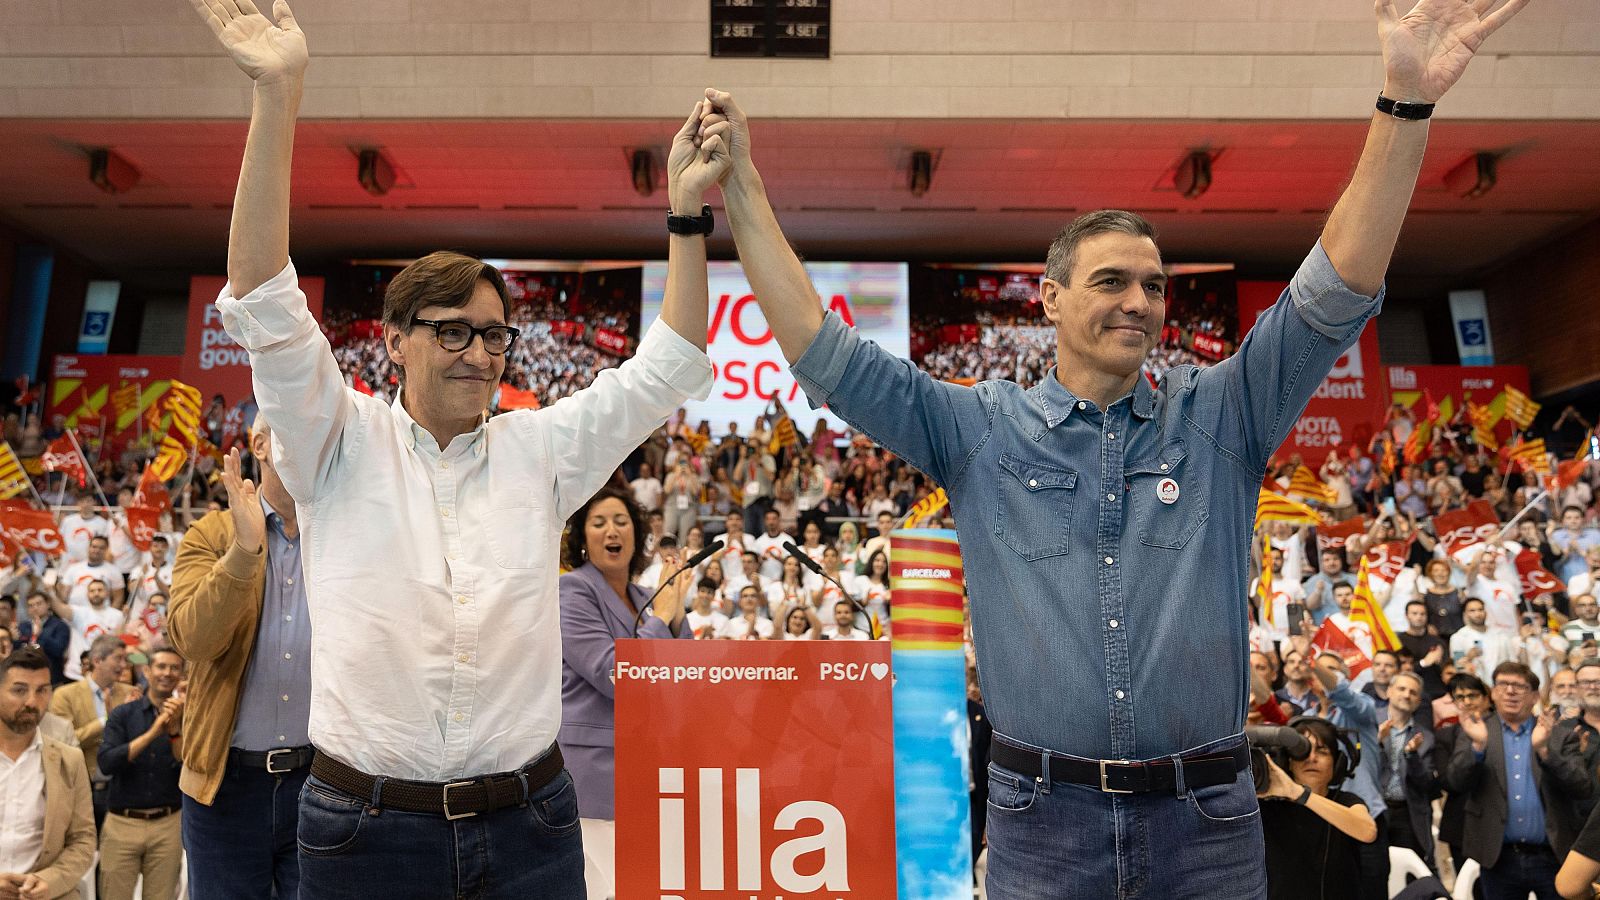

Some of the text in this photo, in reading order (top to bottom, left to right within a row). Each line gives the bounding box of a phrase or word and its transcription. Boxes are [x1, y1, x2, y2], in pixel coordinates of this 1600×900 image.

[722, 24, 755, 37] 2 SET
[786, 24, 819, 37] 4 SET
[1295, 416, 1341, 434] VOTA
[902, 568, 951, 579] BARCELONA
[616, 661, 671, 684] Força
[673, 666, 706, 684] per
[708, 666, 799, 684] governar.
[658, 767, 851, 894] illa
